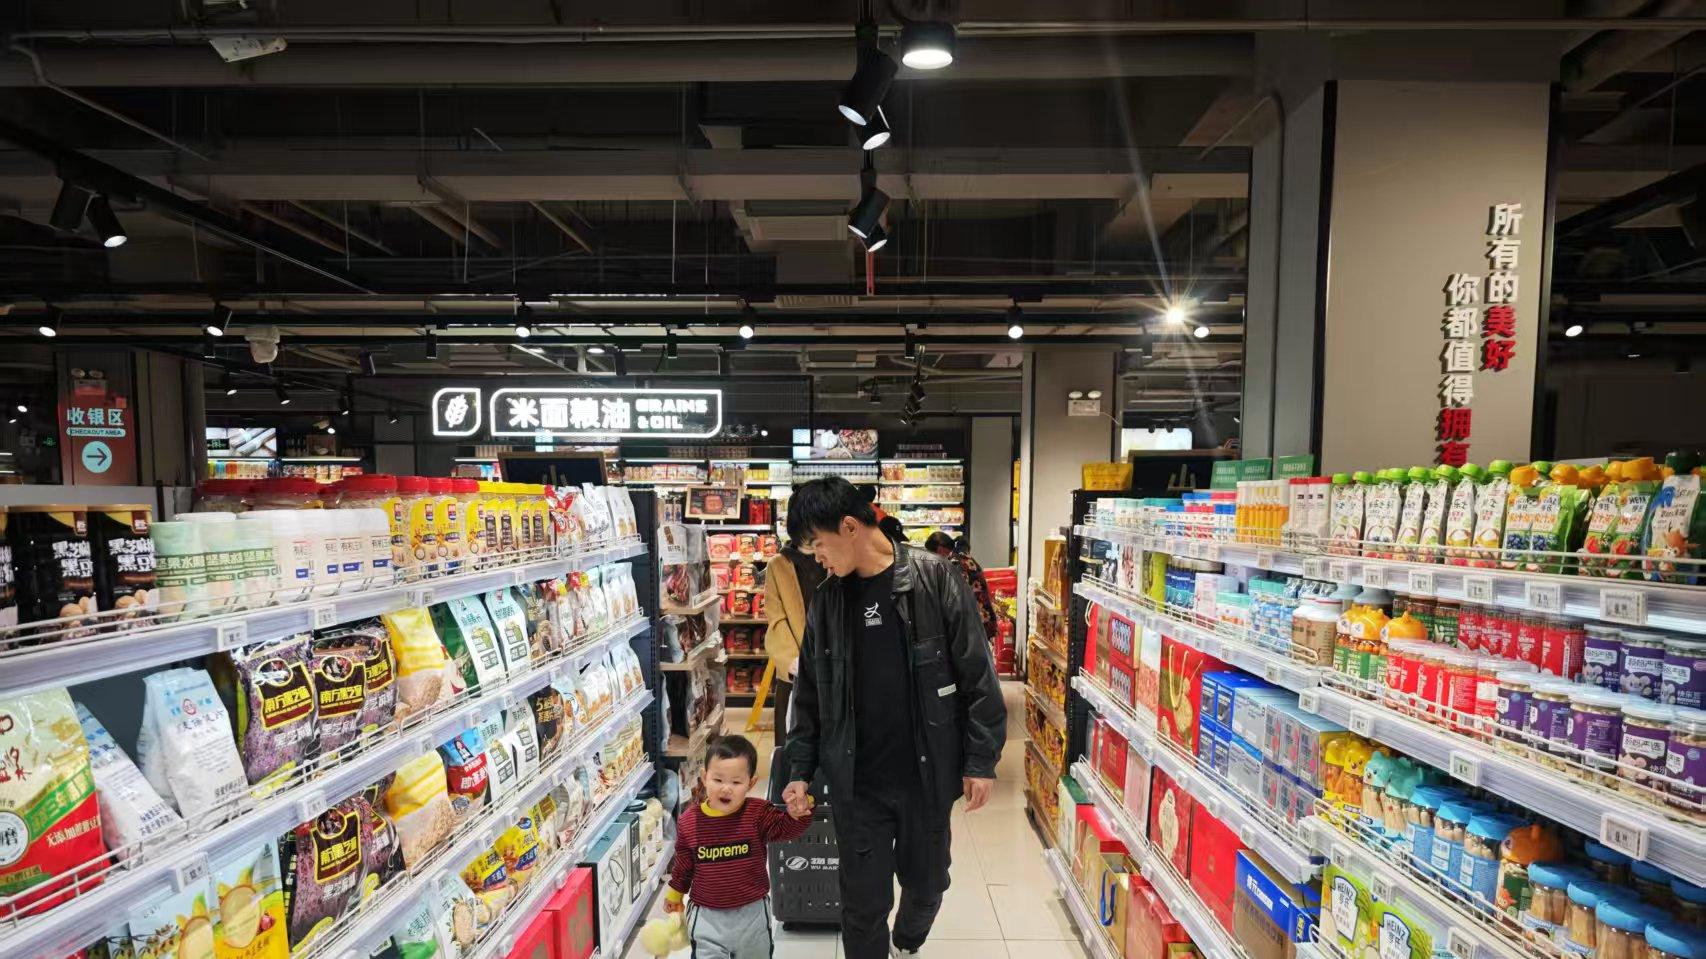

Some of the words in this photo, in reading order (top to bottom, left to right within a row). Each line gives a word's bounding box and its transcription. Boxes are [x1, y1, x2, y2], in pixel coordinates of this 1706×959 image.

[1483, 203, 1523, 370] 所有的美好
[1440, 273, 1481, 468] 你都值得拥有
[506, 397, 631, 429] 米面粮油
[635, 399, 708, 413] GRAINS
[67, 407, 124, 425] 收银区
[108, 538, 155, 556] 黑芝麻
[320, 684, 363, 704] 南方黑芝麻
[697, 843, 749, 861] Supreme
[1337, 882, 1354, 900] HEINZ
[1386, 919, 1406, 941] HEINZ
